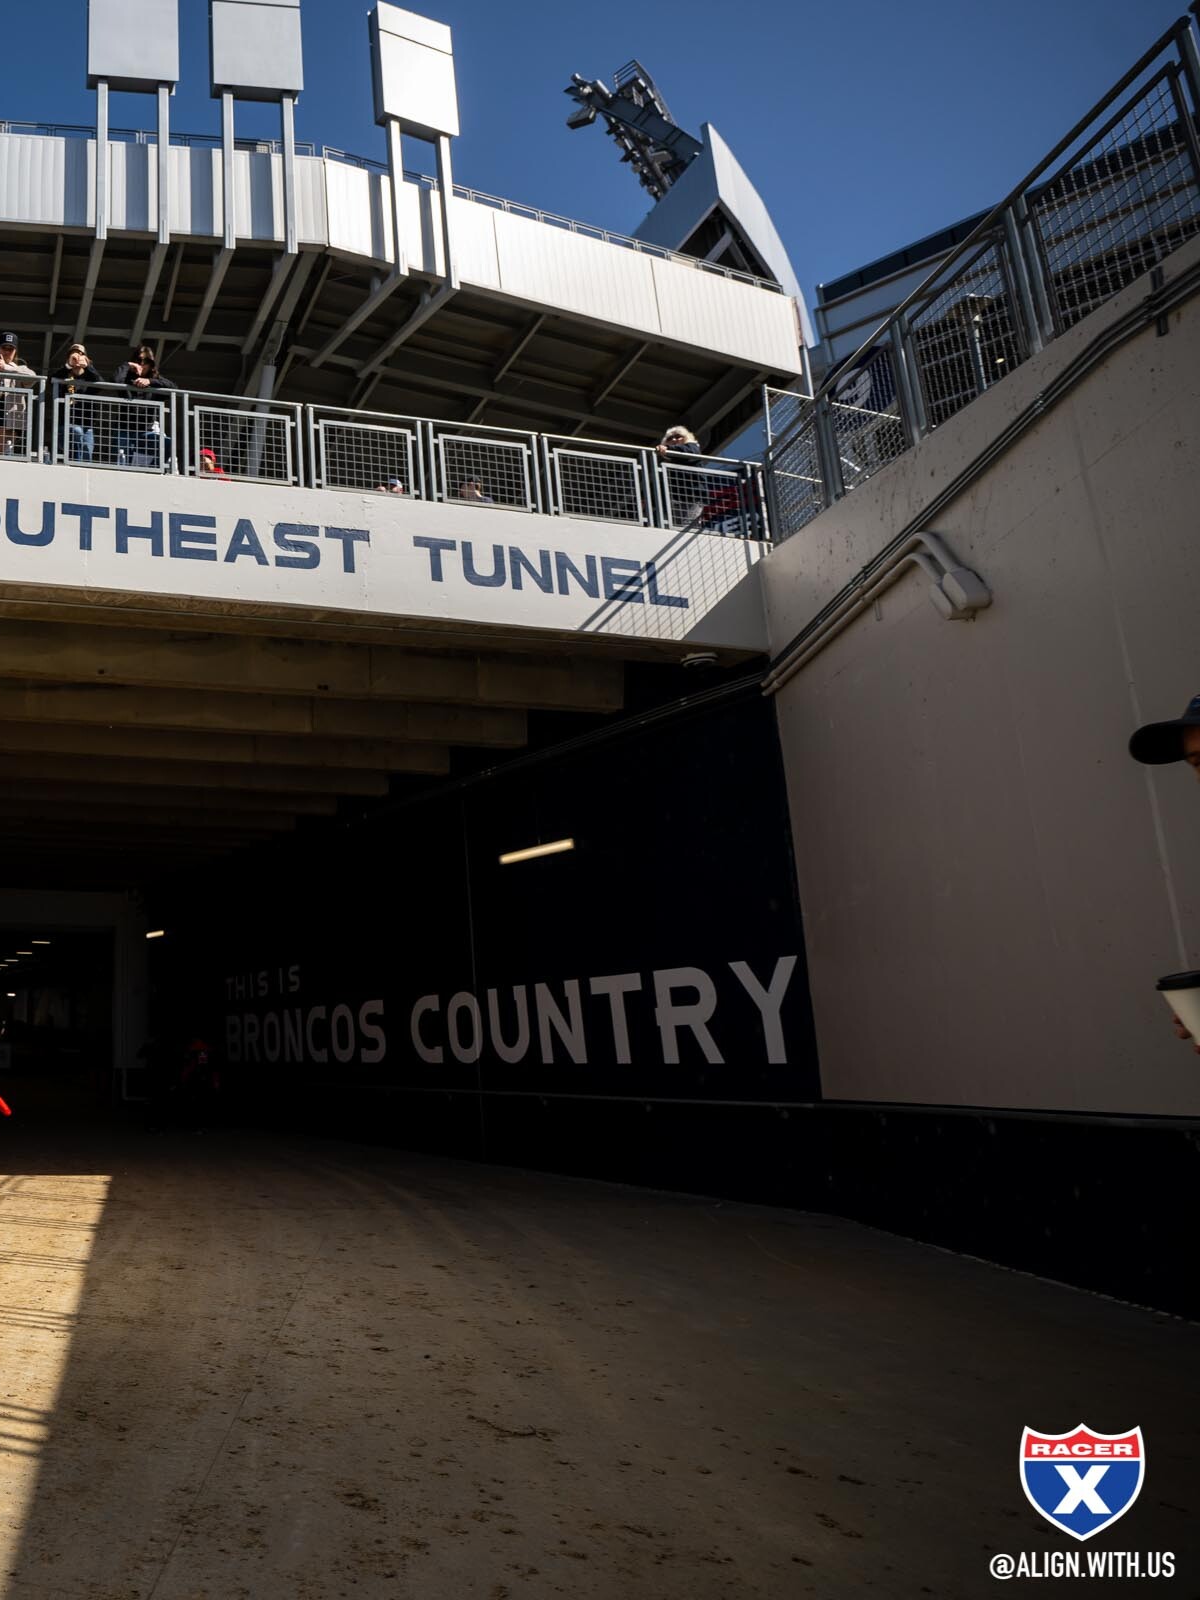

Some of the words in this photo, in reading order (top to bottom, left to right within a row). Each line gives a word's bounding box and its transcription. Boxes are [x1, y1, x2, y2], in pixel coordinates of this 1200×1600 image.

[414, 536, 690, 608] TUNNEL
[226, 970, 268, 1000] THIS
[279, 965, 301, 993] IS
[226, 1000, 387, 1063] BRONCOS
[410, 955, 798, 1064] COUNTRY
